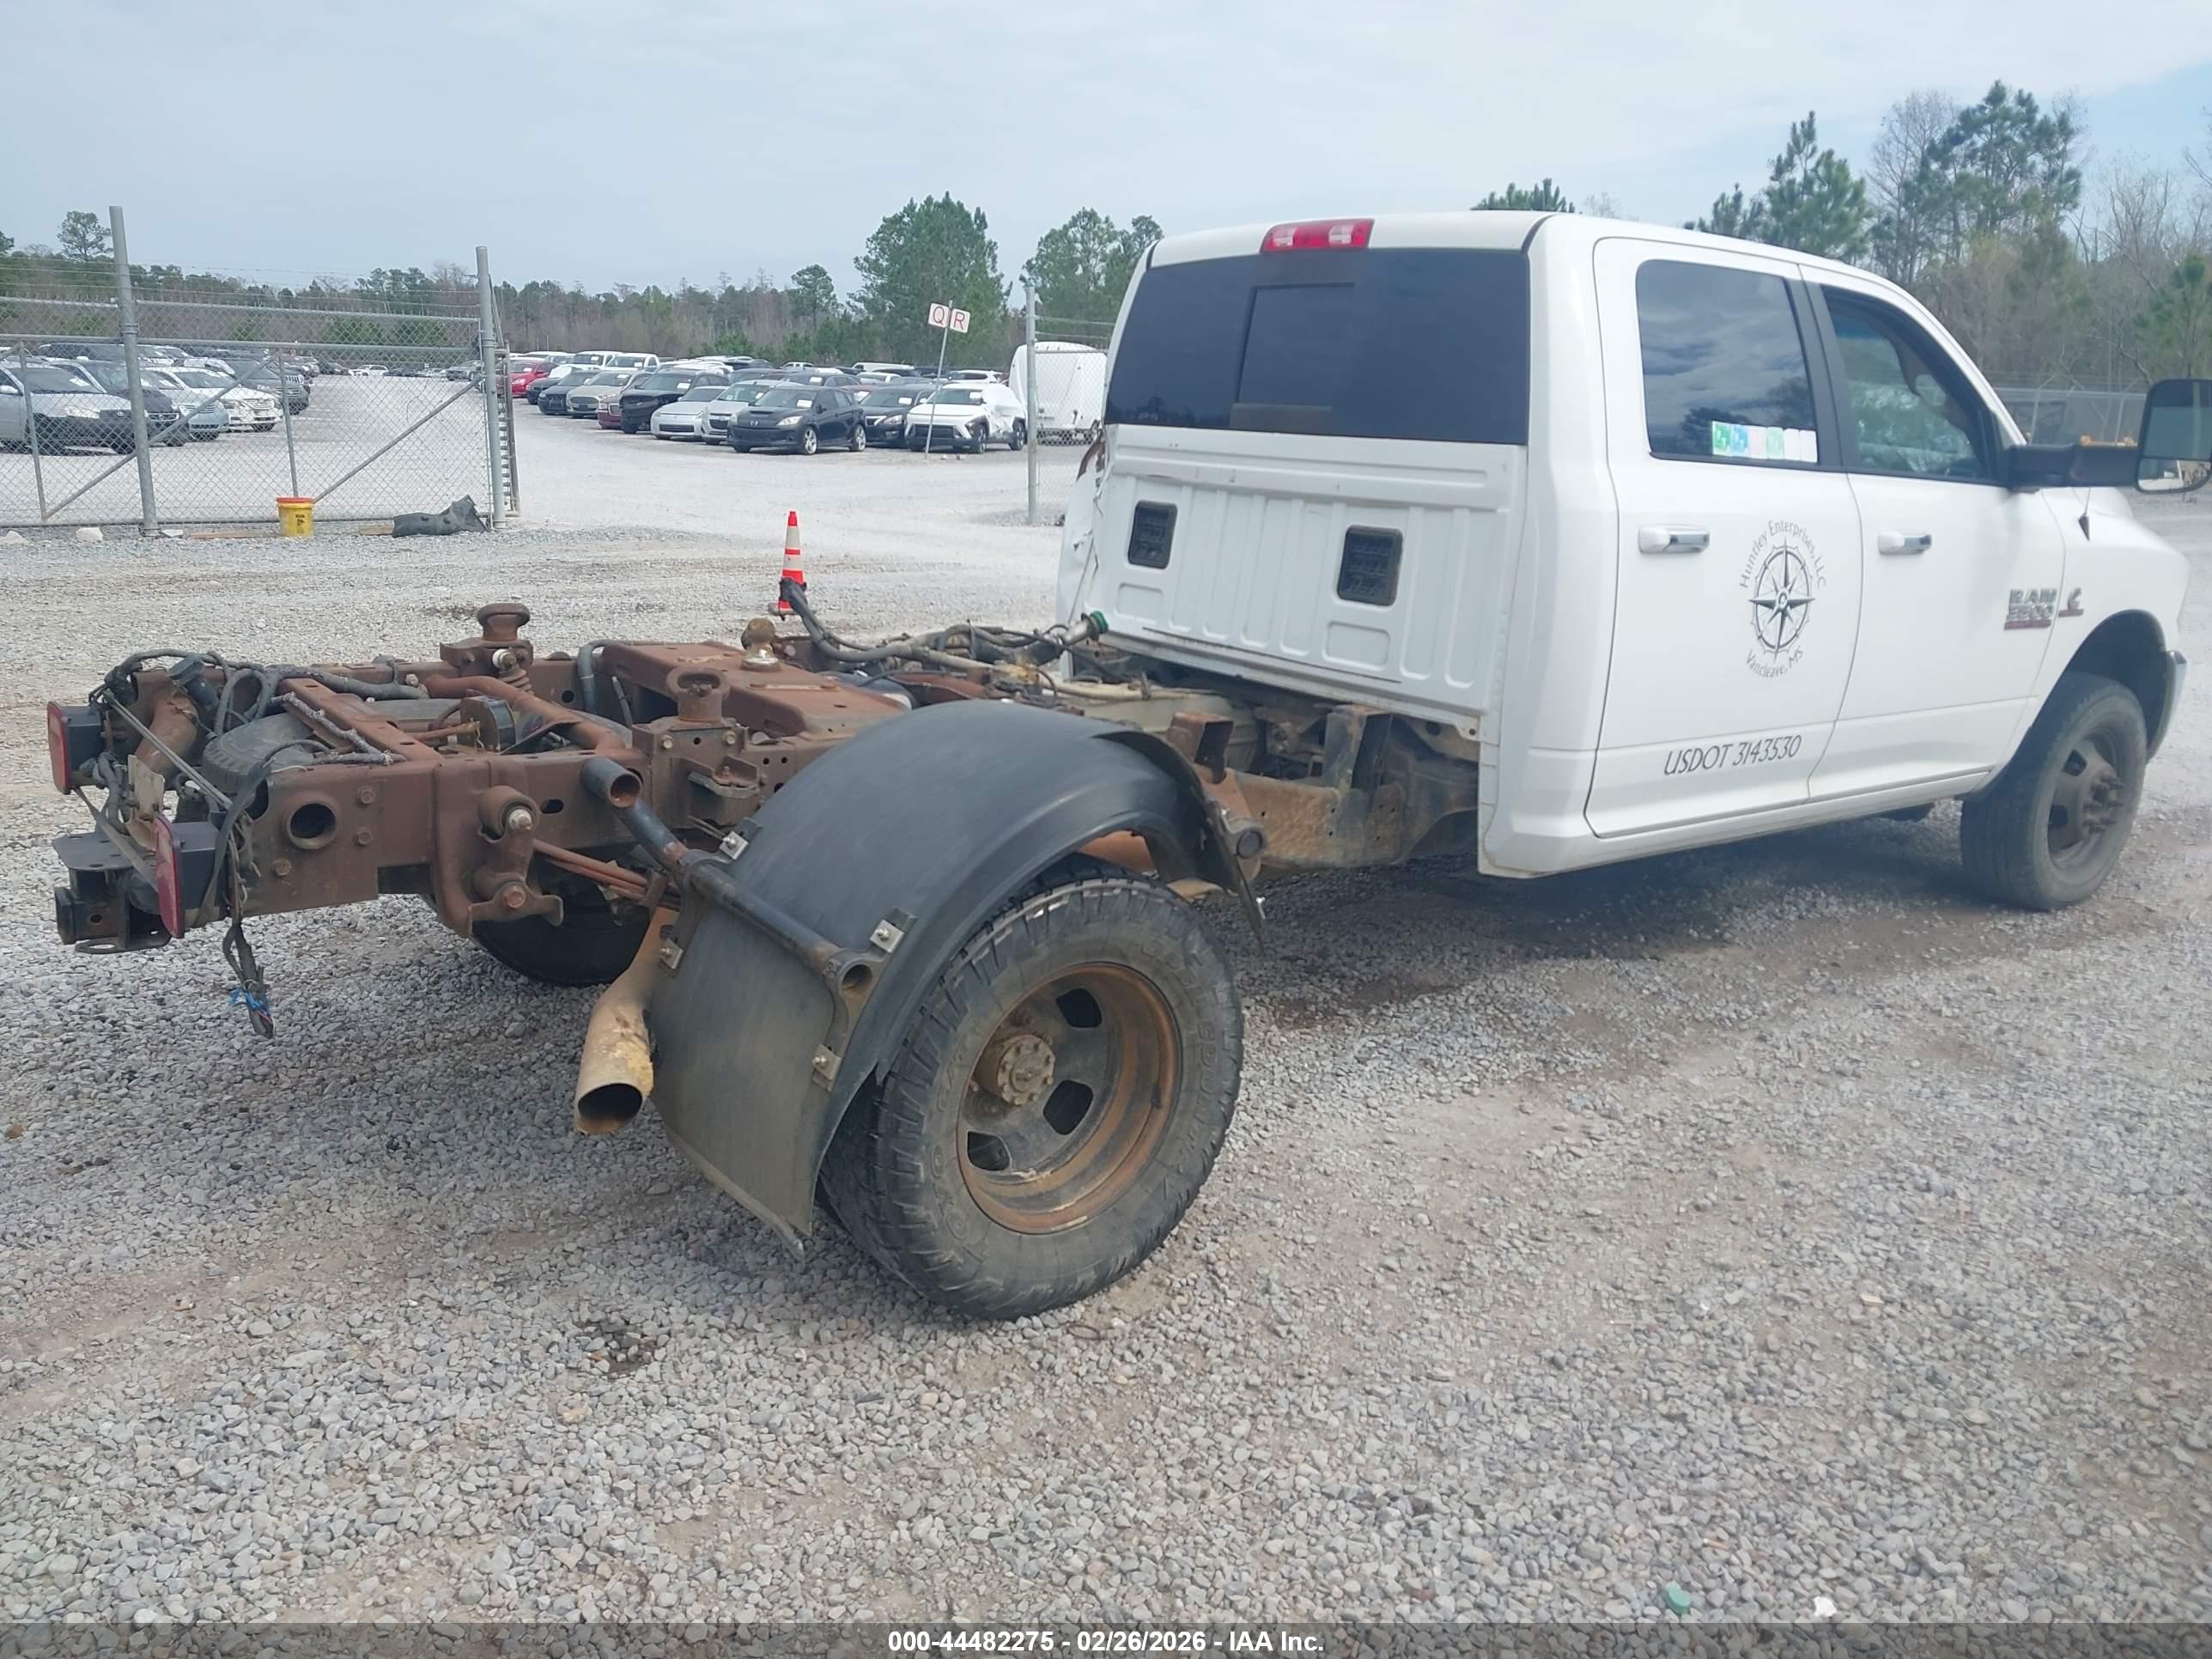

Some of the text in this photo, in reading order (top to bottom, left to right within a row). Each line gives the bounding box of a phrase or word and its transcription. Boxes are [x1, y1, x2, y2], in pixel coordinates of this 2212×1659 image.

[933, 306, 945, 325] Q
[953, 311, 966, 331] R
[1740, 519, 1827, 591] Huntley Enterprises, LLC
[2008, 588, 2058, 604] RAM
[1788, 645, 1804, 669] MS
[1663, 734, 1802, 775] USDOT 3143530
